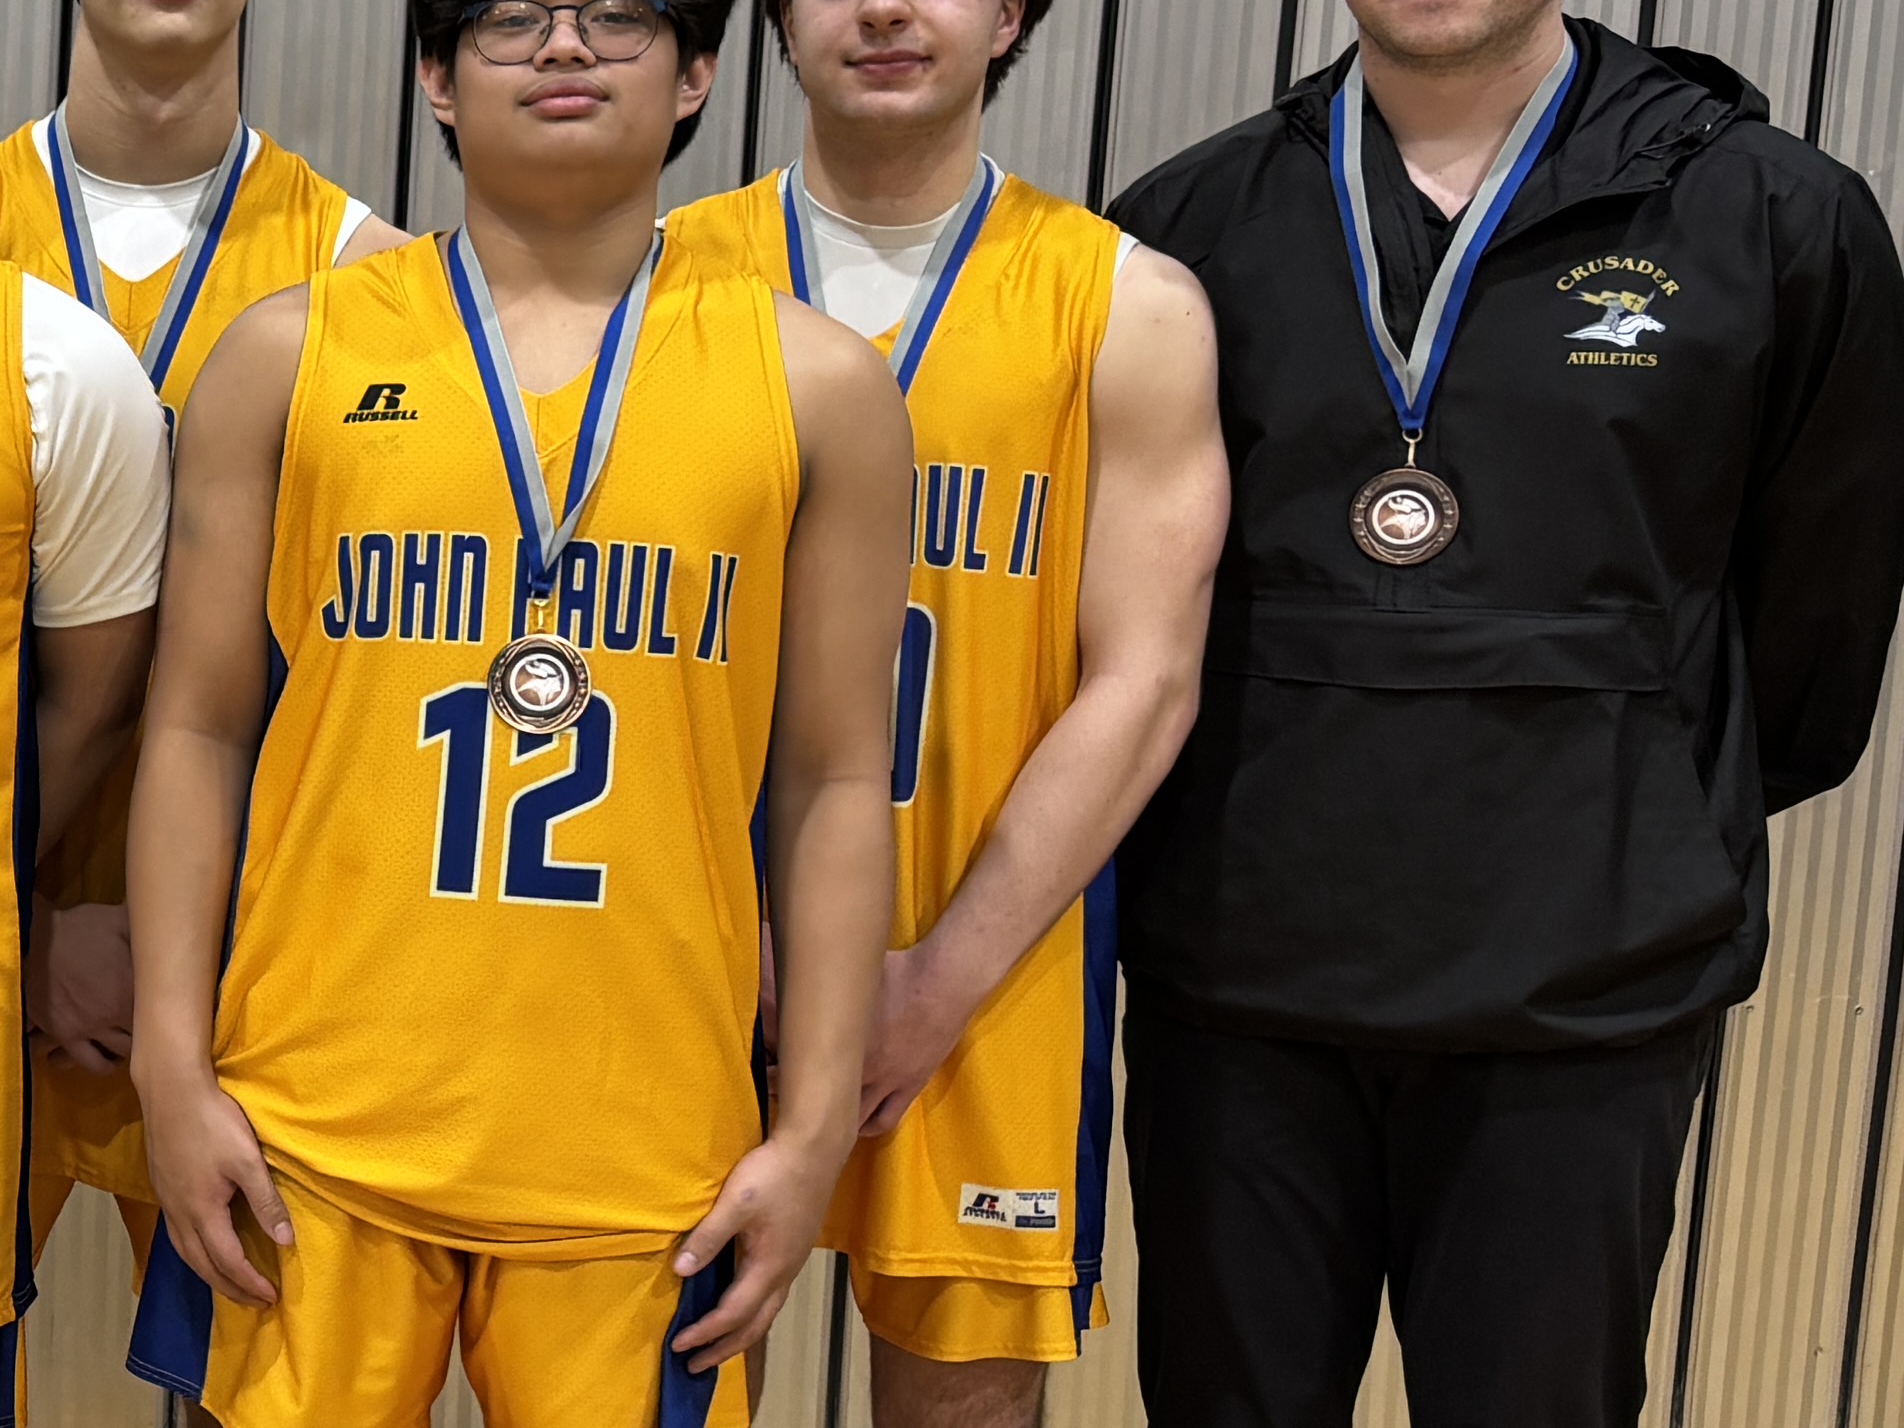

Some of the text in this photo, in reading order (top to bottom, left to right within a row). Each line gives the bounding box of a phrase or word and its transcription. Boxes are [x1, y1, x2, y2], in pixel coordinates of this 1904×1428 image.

[1556, 255, 1680, 297] CRUSADER
[1566, 351, 1658, 367] ATHLETICS
[343, 409, 418, 423] RUSSELL
[911, 462, 988, 573] UL
[321, 531, 489, 645] JOHN
[417, 681, 617, 910] 12
